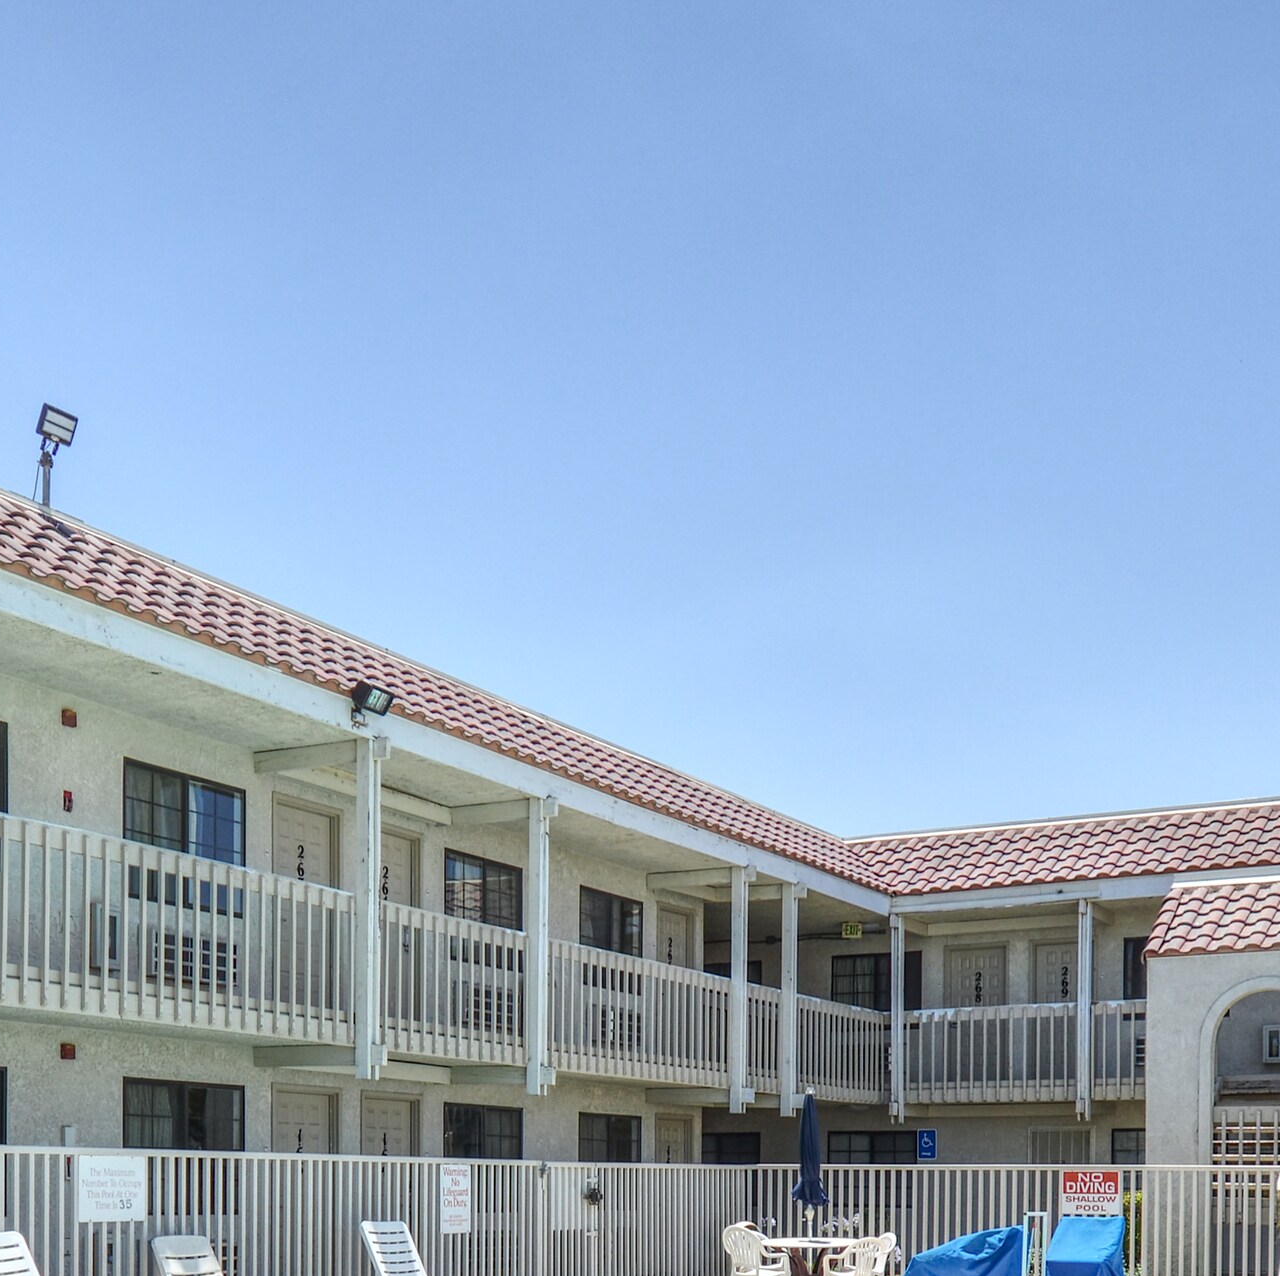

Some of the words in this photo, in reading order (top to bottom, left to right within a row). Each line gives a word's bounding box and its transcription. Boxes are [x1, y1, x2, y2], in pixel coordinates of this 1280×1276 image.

[297, 844, 305, 881] 26
[1061, 966, 1069, 998] 269
[90, 1168, 101, 1176] The
[103, 1168, 136, 1176] Maximum
[1078, 1172, 1104, 1182] NO
[81, 1178, 108, 1188] Number
[110, 1178, 117, 1188] To
[119, 1178, 142, 1189] Occupy
[451, 1177, 460, 1187] No
[1066, 1181, 1116, 1193] DIVING
[87, 1190, 100, 1199] This
[102, 1190, 114, 1199] Pool
[116, 1190, 123, 1199] At
[124, 1190, 138, 1199] One
[443, 1187, 468, 1197] Lifeguard
[443, 1198, 453, 1208] On
[1065, 1195, 1117, 1203] SHALLOW
[95, 1200, 111, 1210] Time
[119, 1199, 133, 1210] 35
[1075, 1204, 1107, 1212] POOL
